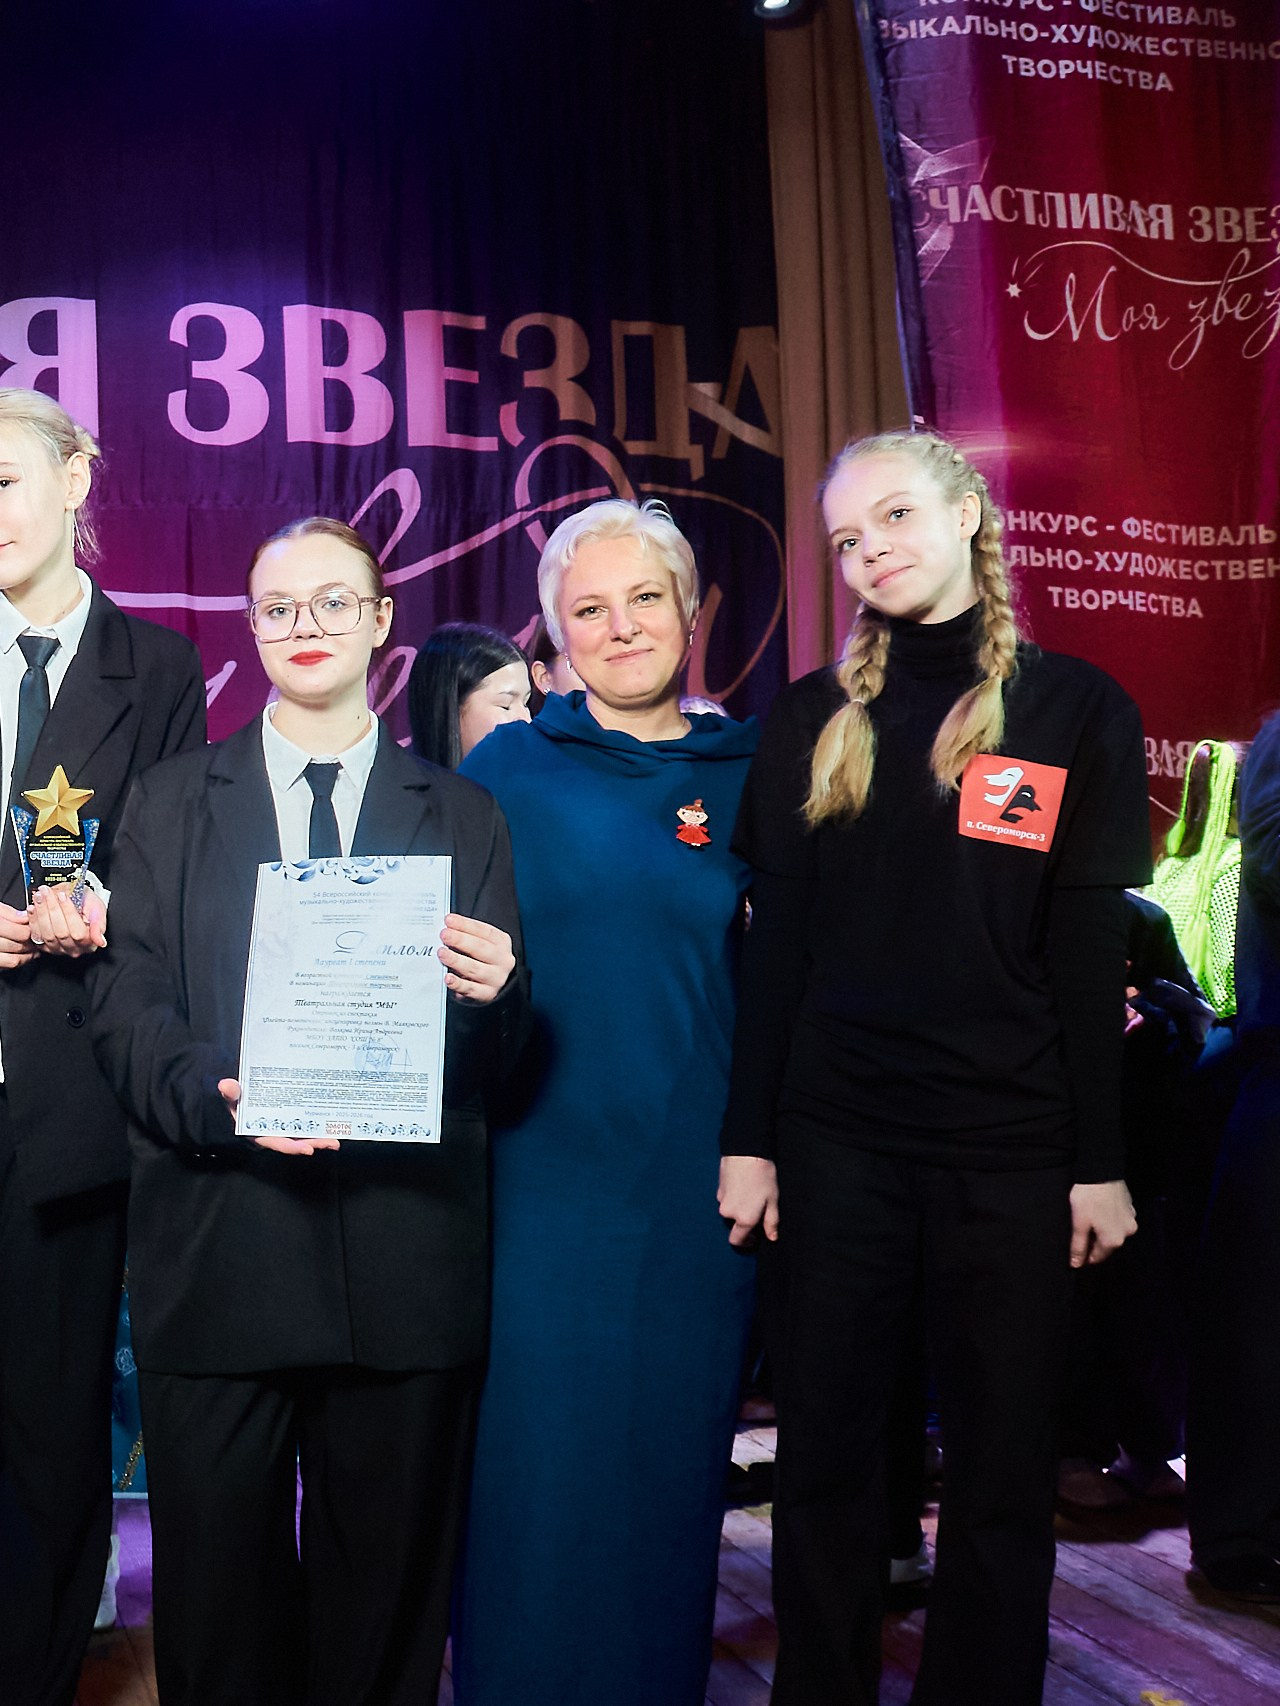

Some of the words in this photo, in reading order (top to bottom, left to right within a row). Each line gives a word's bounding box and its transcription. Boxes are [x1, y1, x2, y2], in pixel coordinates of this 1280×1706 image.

[1001, 54, 1175, 92] ТВОРЧЕСТВА
[1024, 265, 1169, 341] Моя
[168, 302, 783, 481] ЗВЕЗДА
[1000, 510, 1098, 537] НКУРС
[1122, 516, 1278, 546] ФЕСТИВАЛЬ
[1047, 586, 1204, 618] ТВОРЧЕСТВА
[976, 821, 1045, 842] Североморск-3
[347, 1000, 373, 1010] студия
